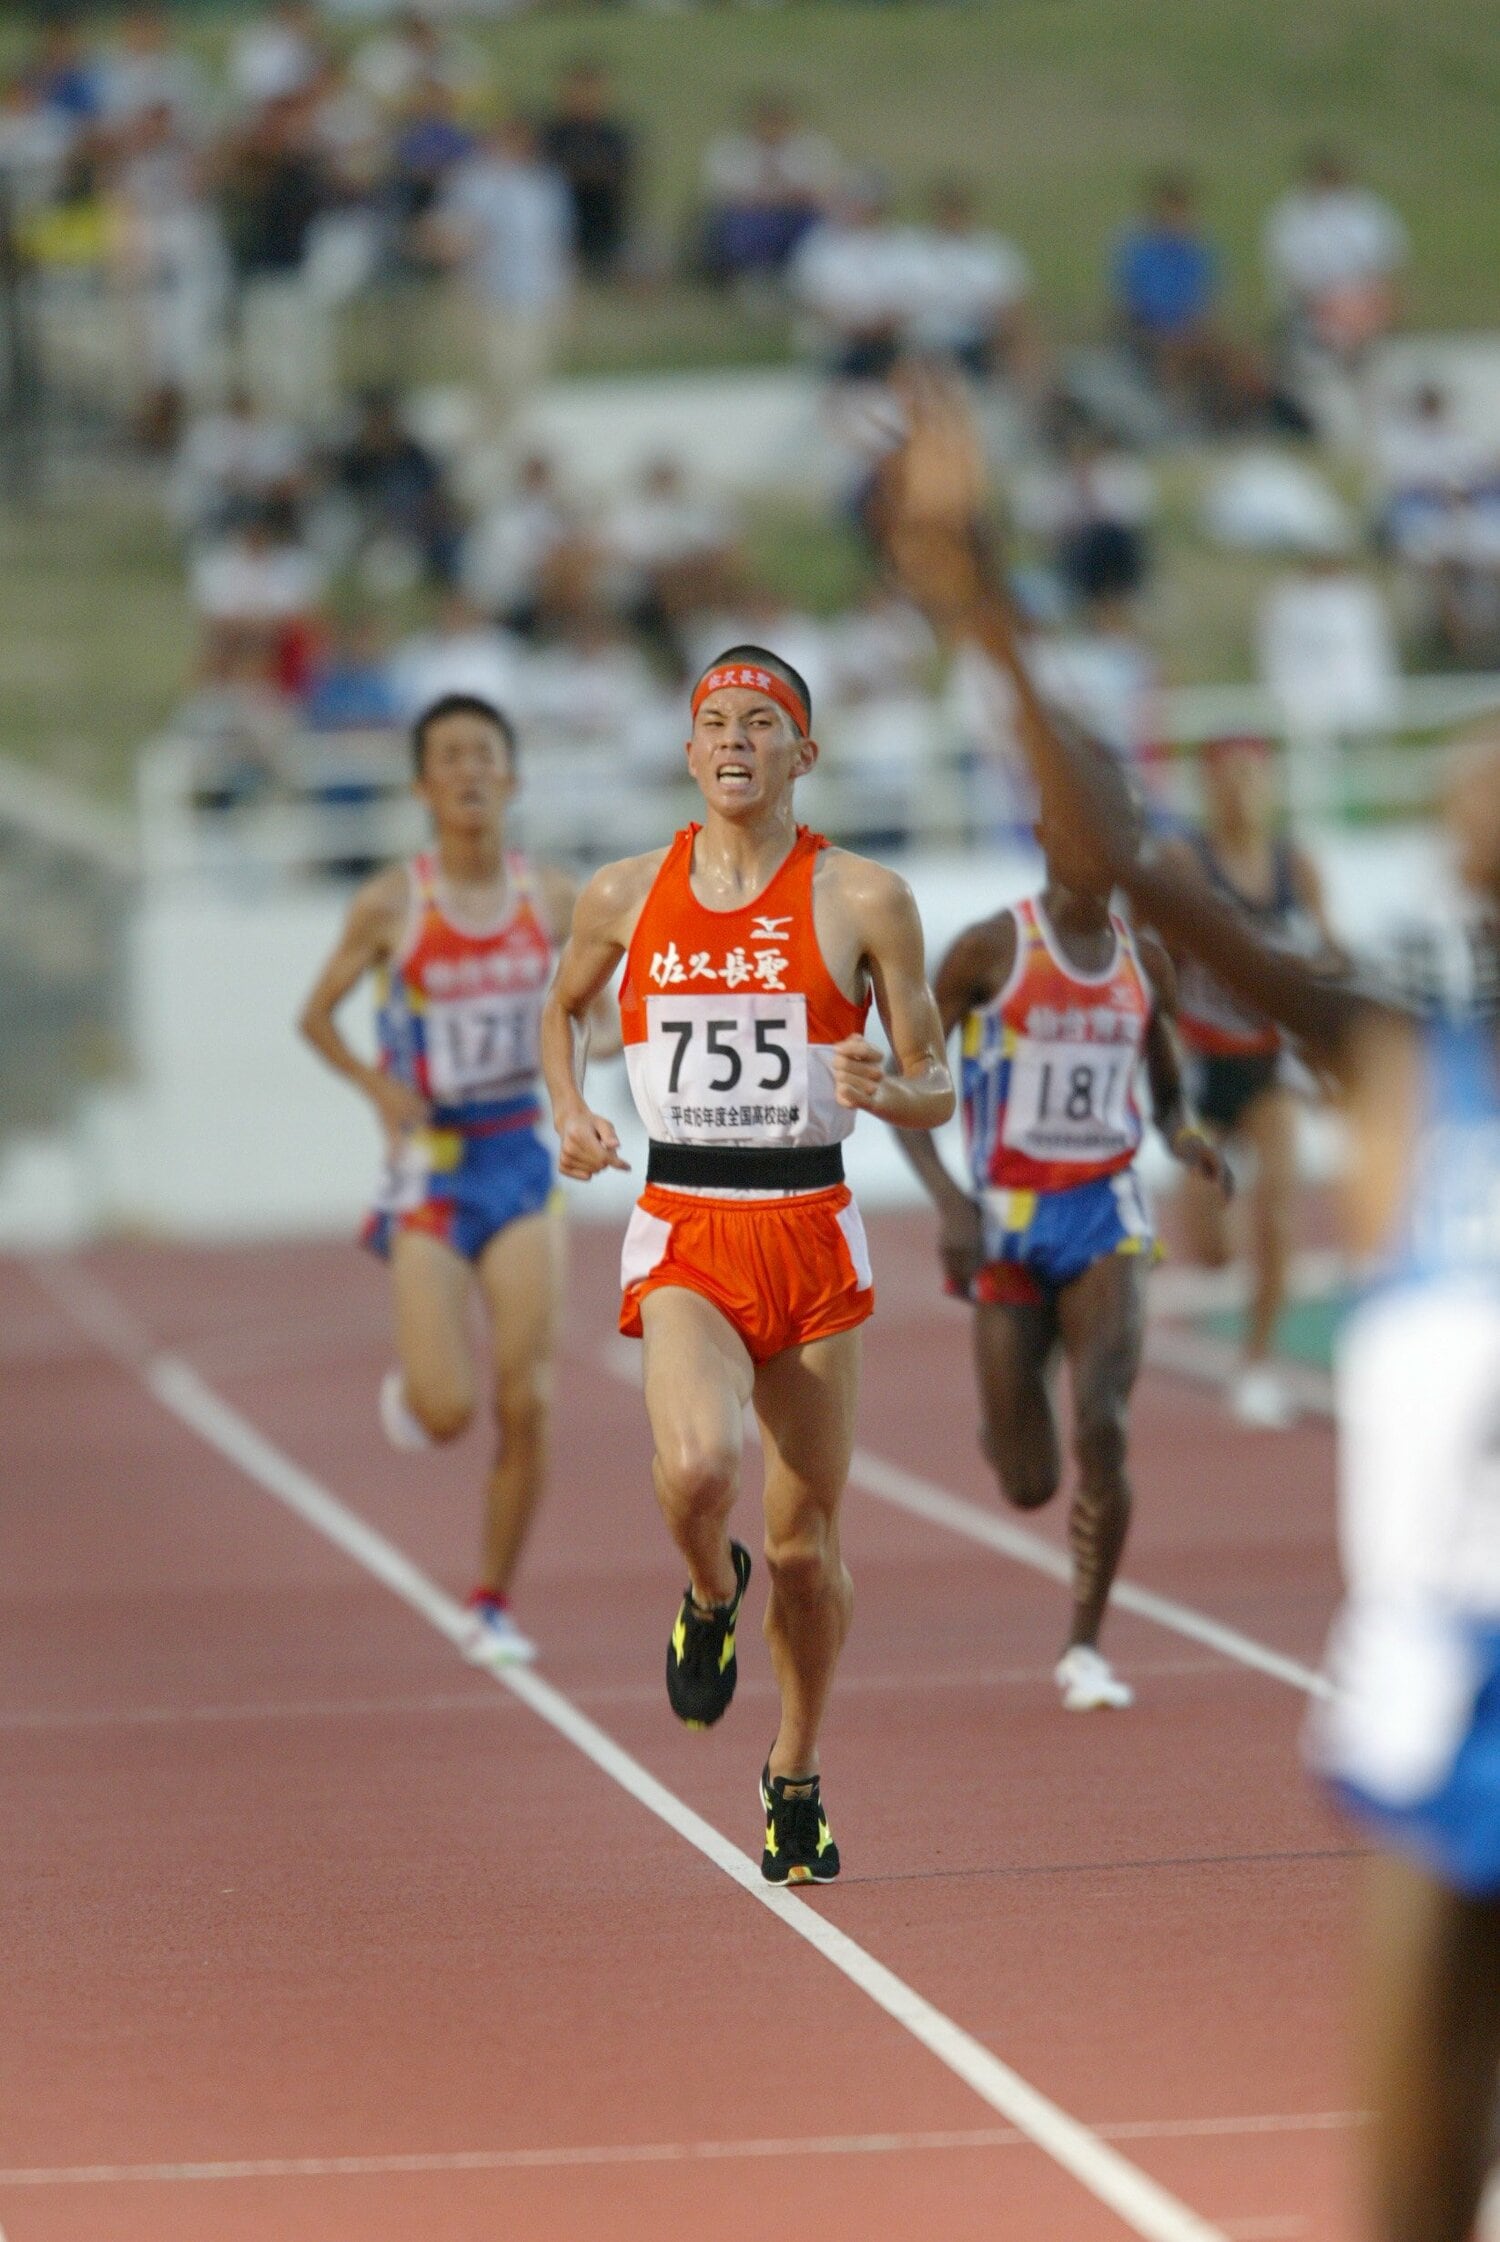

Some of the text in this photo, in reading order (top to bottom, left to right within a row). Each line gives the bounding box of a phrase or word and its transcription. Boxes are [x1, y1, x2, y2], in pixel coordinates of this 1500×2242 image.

[649, 941, 790, 991] 佐久長聖
[661, 1018, 791, 1093] 755
